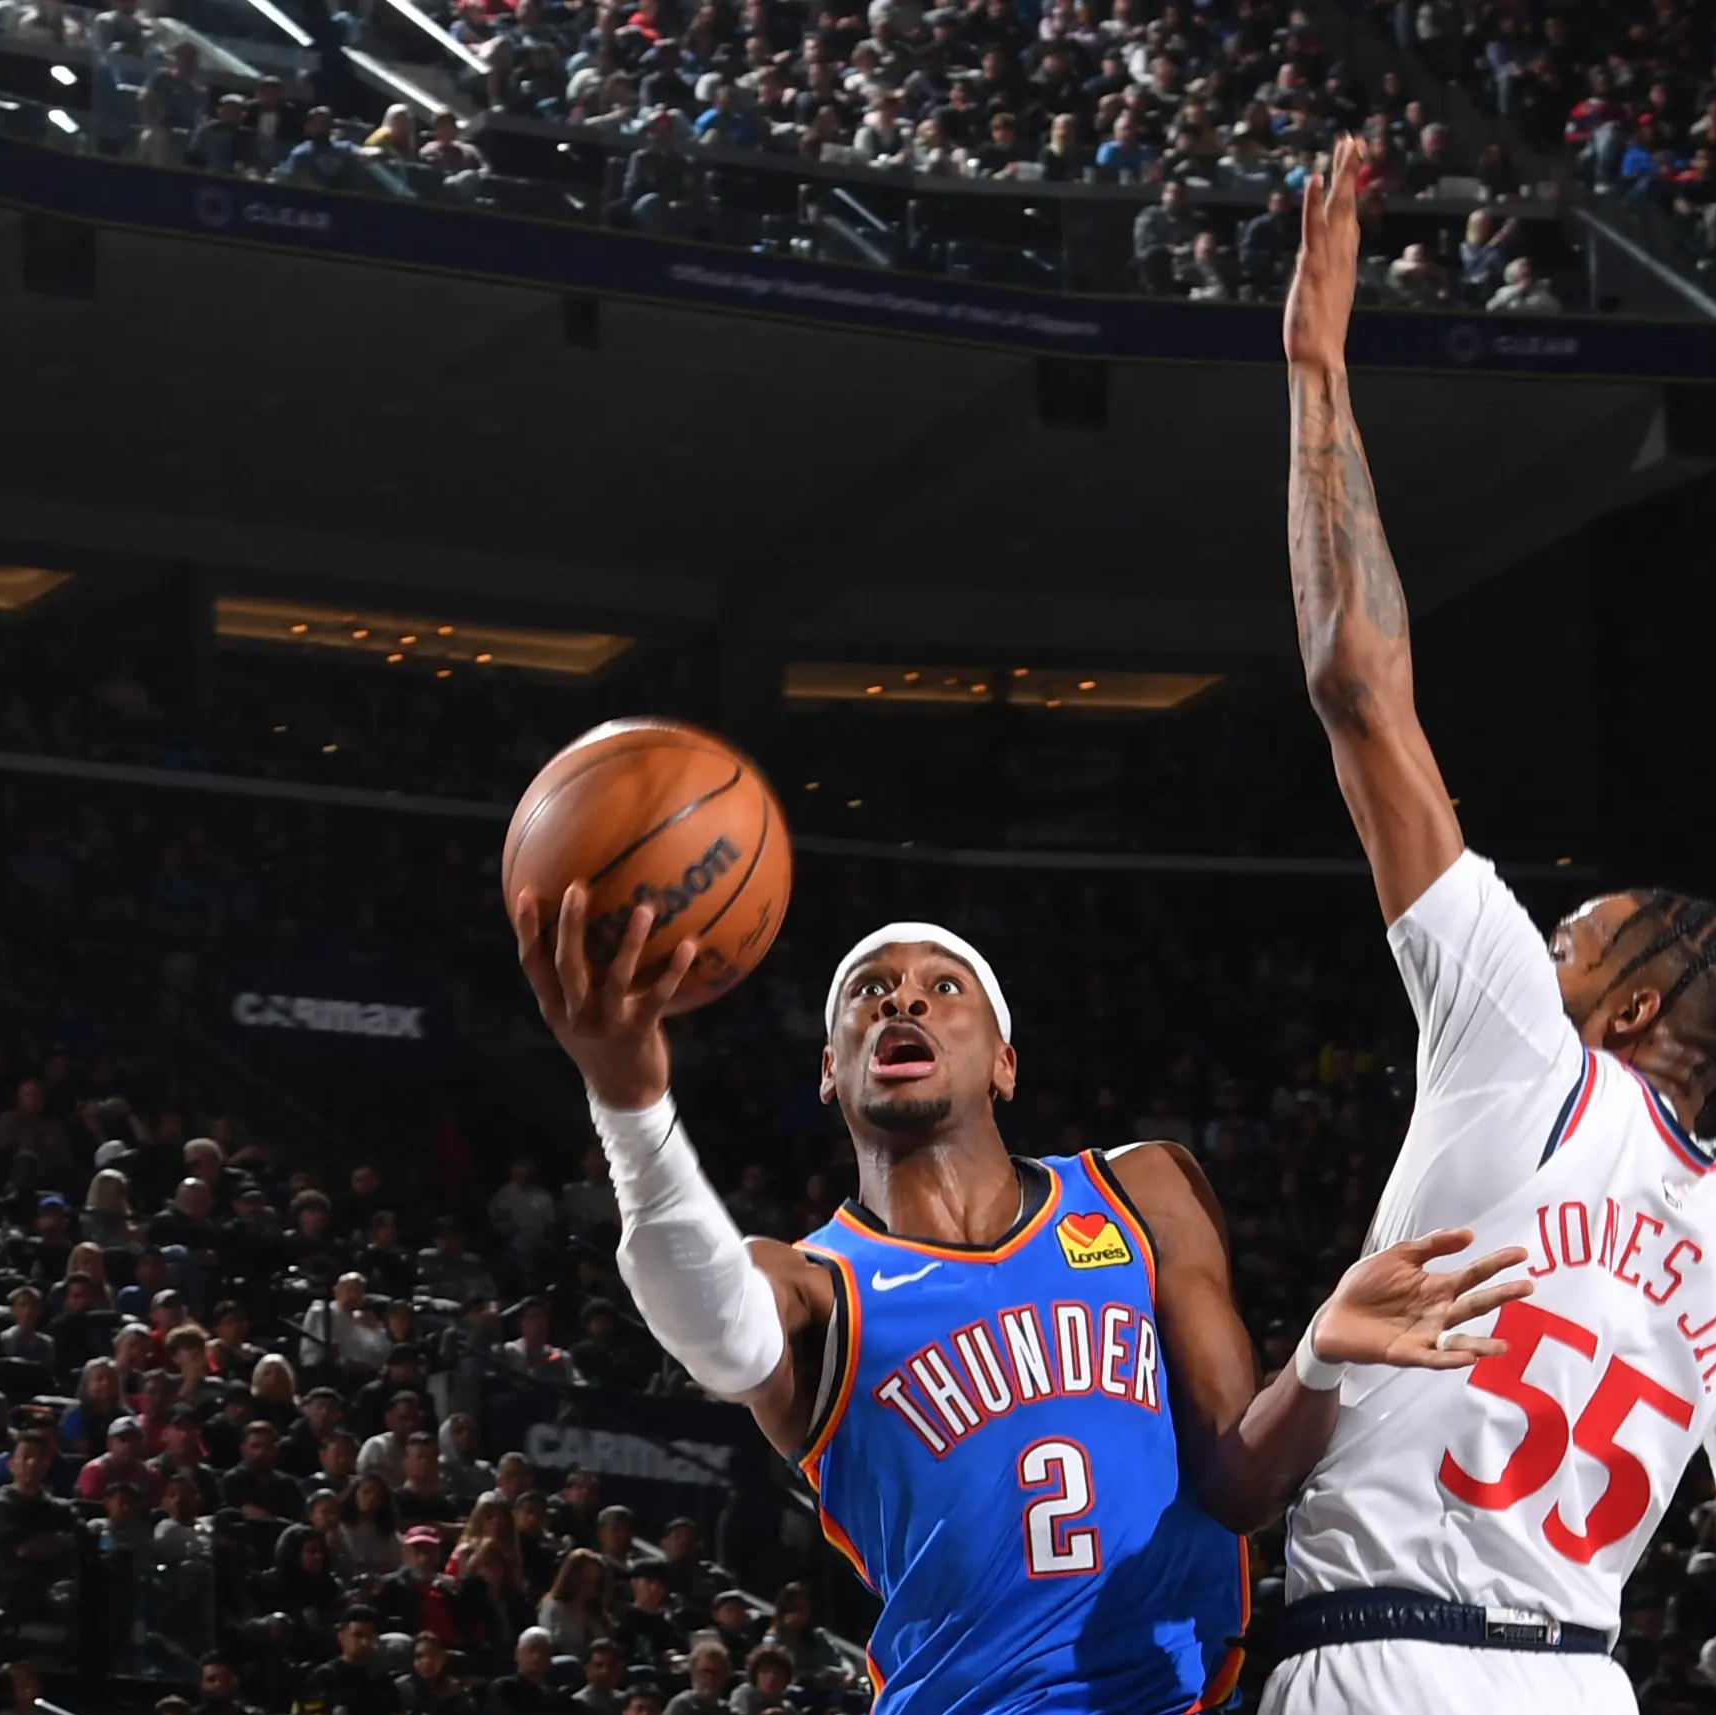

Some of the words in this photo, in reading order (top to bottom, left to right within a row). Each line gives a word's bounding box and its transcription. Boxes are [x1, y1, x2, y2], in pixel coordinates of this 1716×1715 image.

[1527, 1197, 1703, 1305] JONES
[872, 1299, 1161, 1460] THUNDER
[1438, 1298, 1695, 1566] 55
[1016, 1435, 1101, 1580] 2
